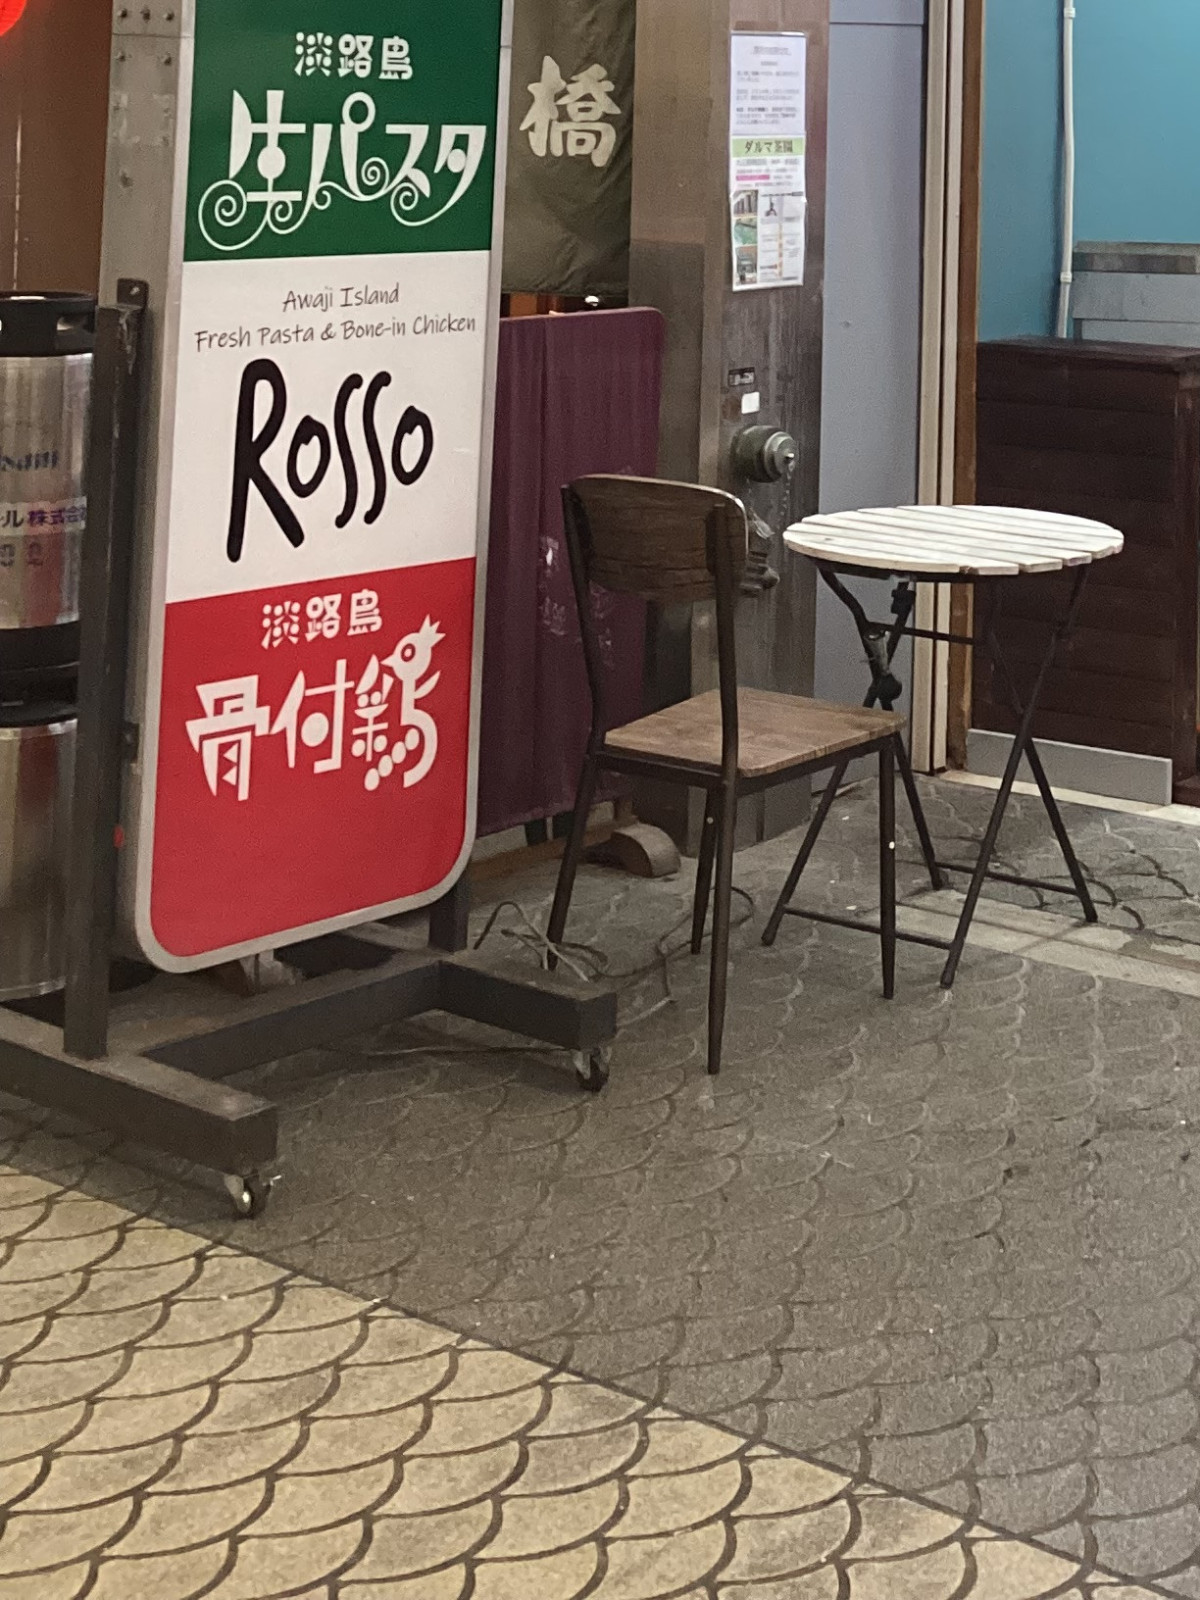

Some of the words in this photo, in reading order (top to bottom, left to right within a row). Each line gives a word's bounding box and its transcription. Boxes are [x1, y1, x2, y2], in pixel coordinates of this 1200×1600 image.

[294, 32, 413, 80] 淡路島
[282, 286, 333, 312] Awaji
[340, 282, 400, 307] Island
[194, 327, 250, 352] Fresh
[258, 324, 314, 345] Pasta
[320, 322, 336, 341] &
[340, 317, 406, 341] Bone-in
[413, 313, 476, 336] Chicken
[261, 589, 382, 650] 淡路島
